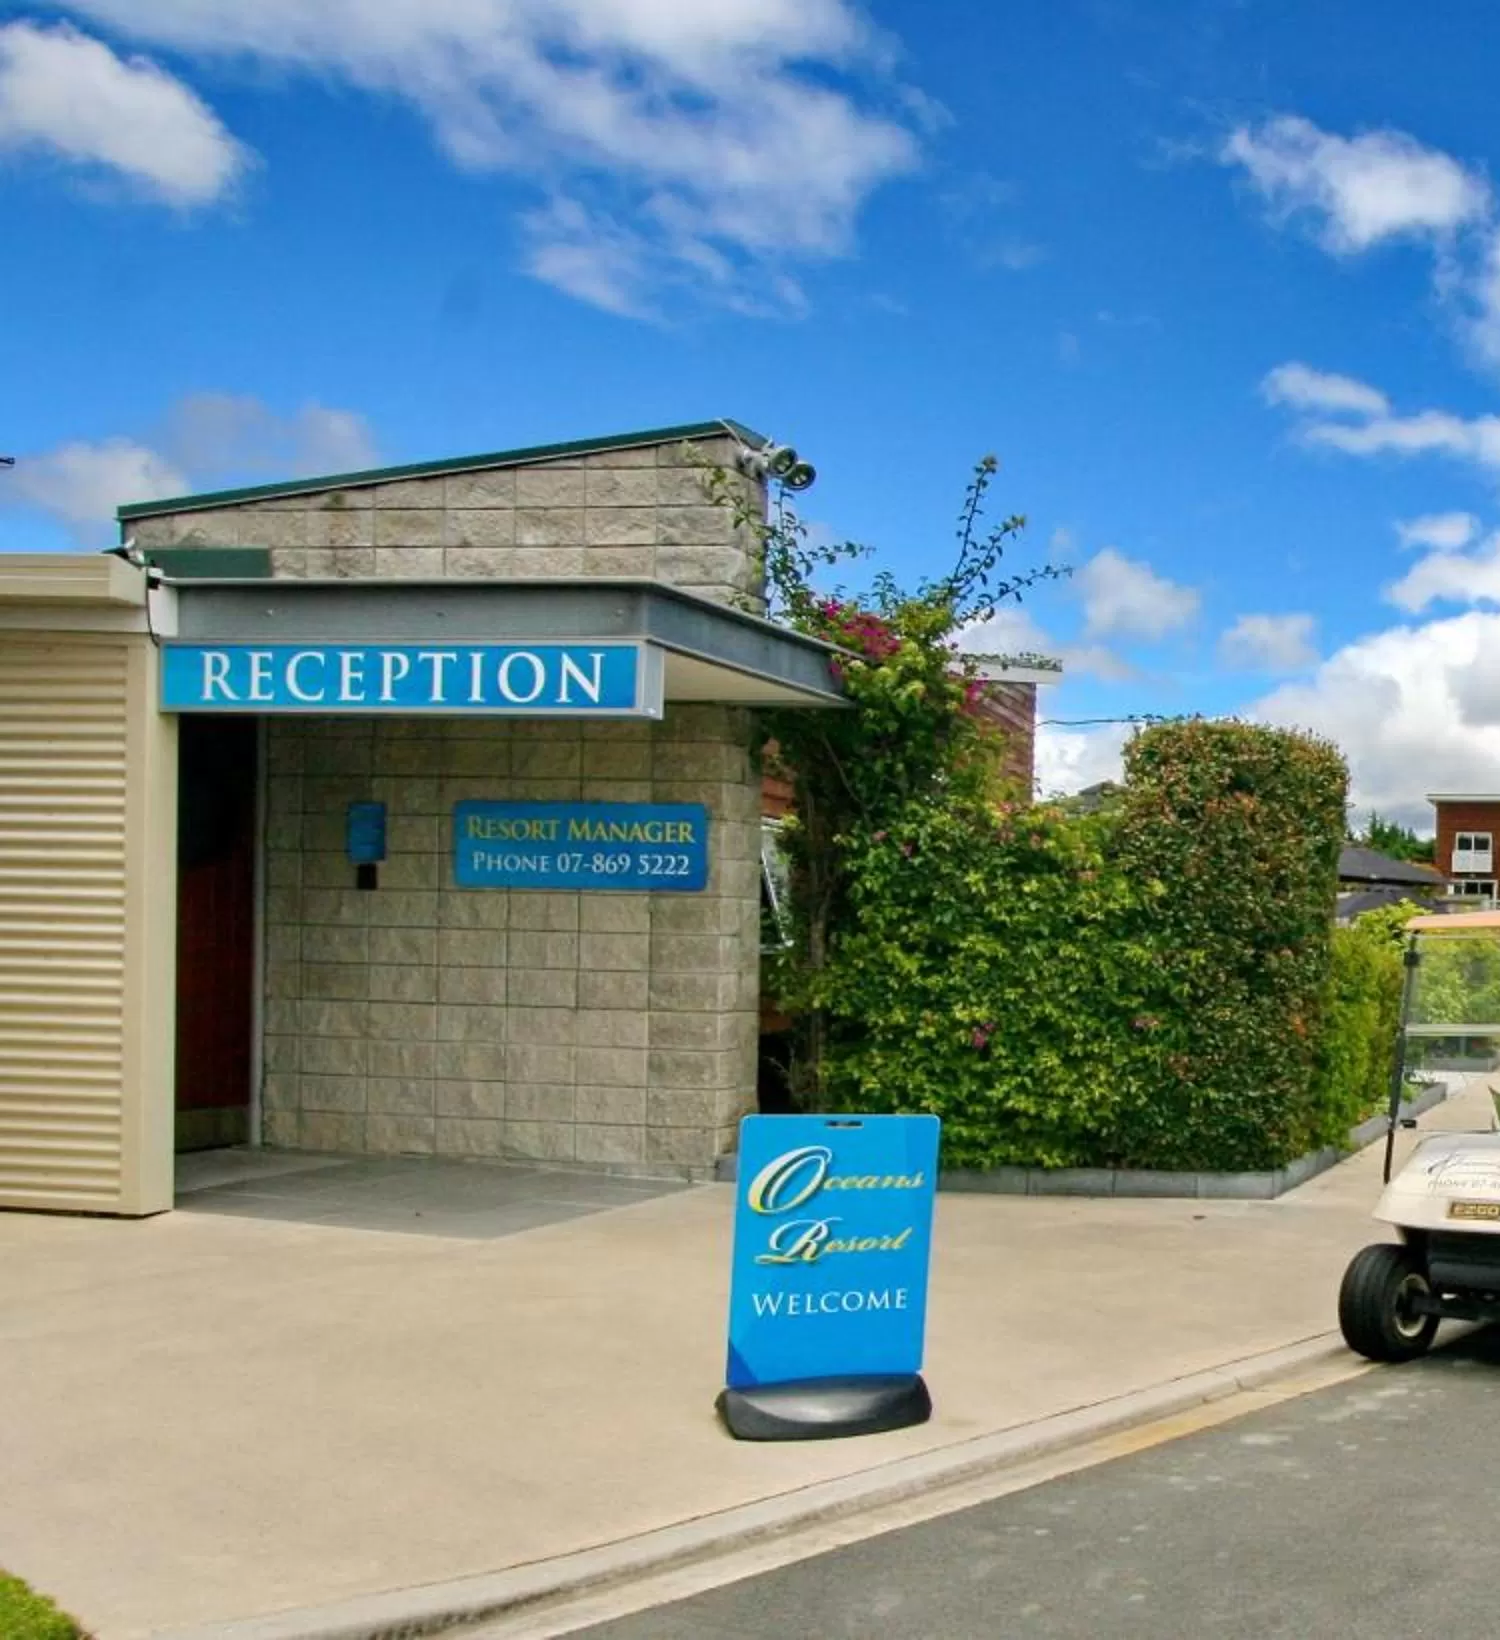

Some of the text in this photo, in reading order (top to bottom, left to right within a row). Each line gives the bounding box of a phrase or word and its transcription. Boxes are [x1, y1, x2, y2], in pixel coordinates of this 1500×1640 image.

[200, 651, 606, 705] RECEPTION
[467, 815, 696, 844] RESORT MANAGER
[472, 851, 690, 876] PHONE 07-869 5222
[748, 1145, 924, 1214] Oceans
[754, 1217, 913, 1264] Resort
[751, 1287, 908, 1318] WELCOME
